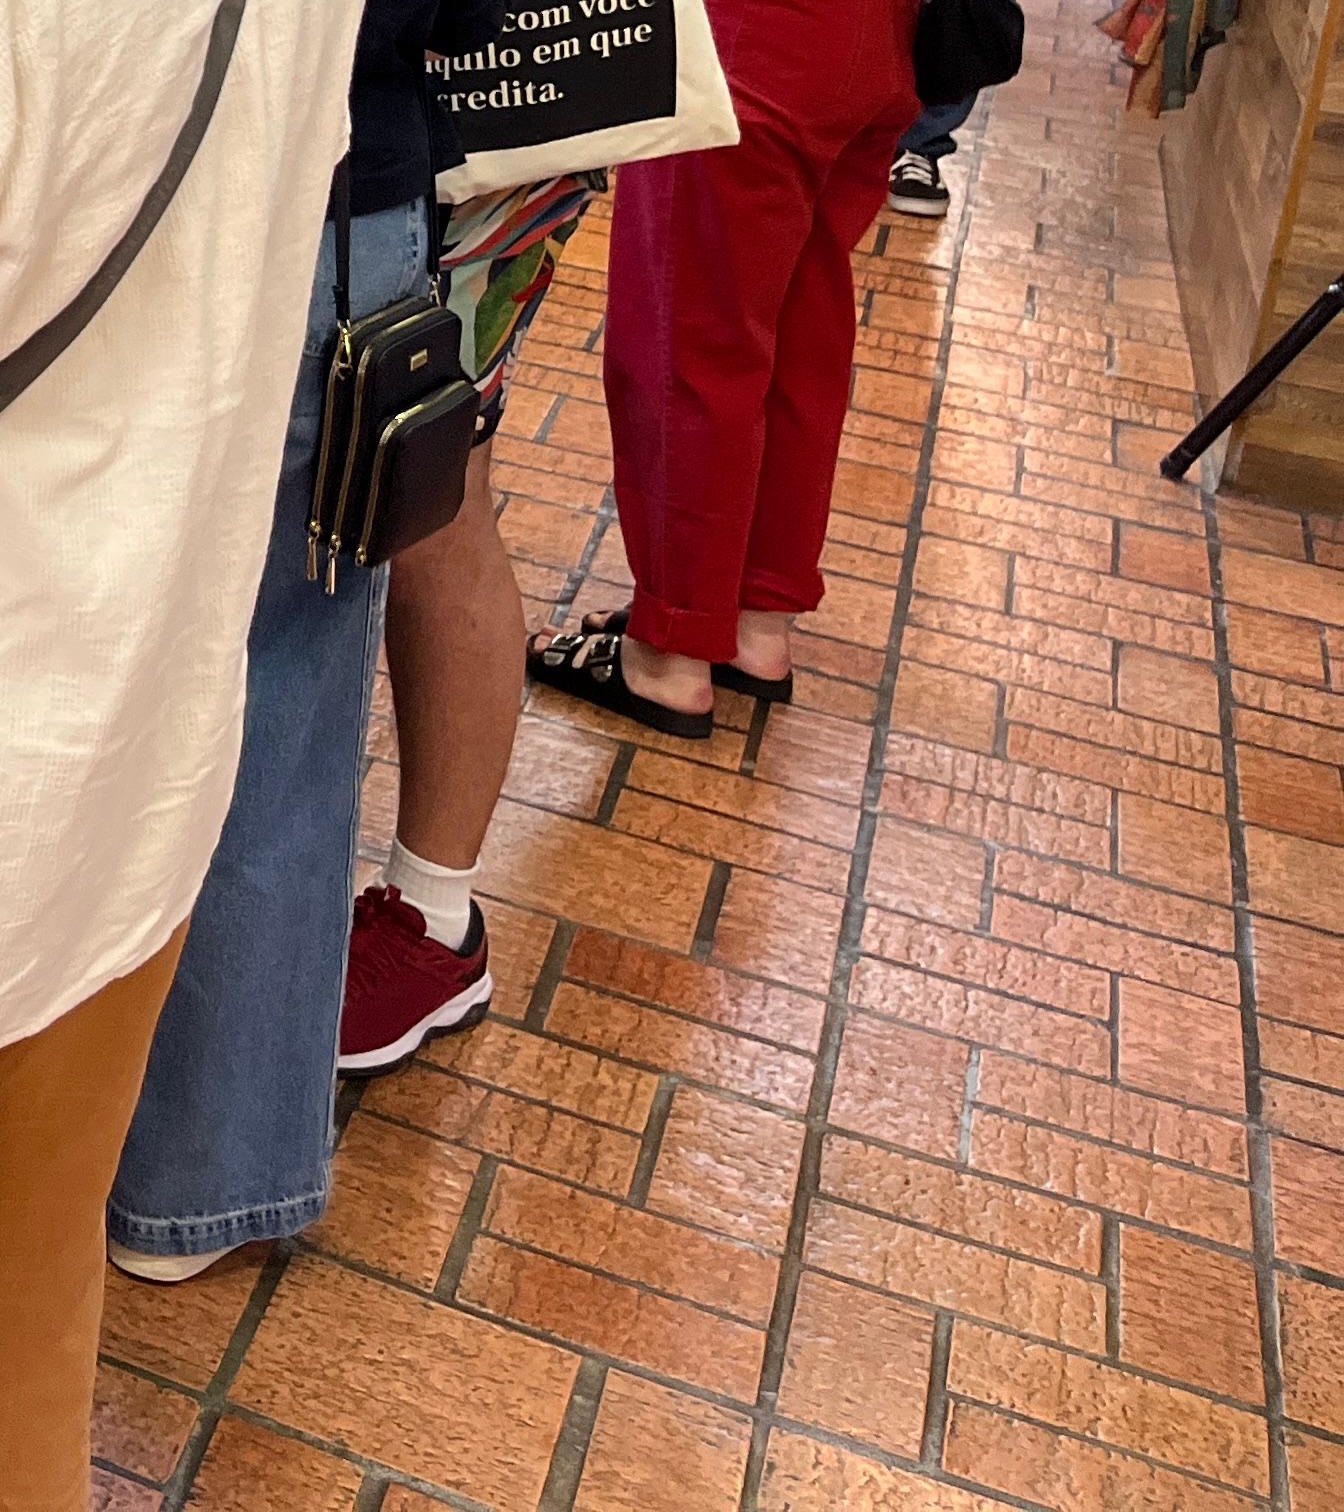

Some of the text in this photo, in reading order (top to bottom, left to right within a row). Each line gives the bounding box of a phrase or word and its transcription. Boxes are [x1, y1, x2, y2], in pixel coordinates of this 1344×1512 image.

[502, 4, 572, 33] com
[532, 37, 581, 65] em
[590, 23, 653, 59] que
